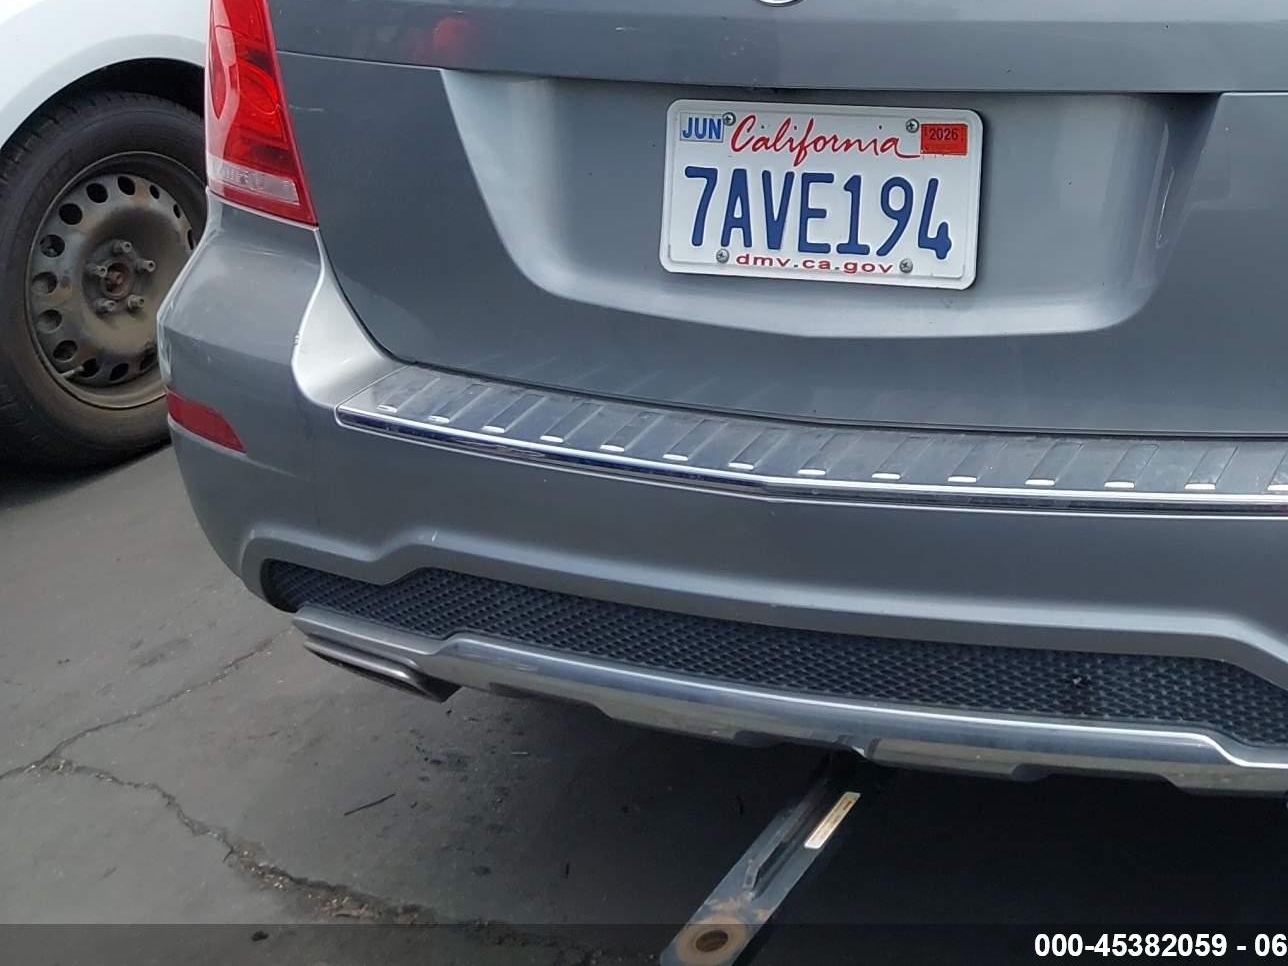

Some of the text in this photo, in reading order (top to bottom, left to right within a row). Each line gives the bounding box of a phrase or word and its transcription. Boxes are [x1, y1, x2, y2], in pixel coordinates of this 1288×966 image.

[682, 116, 722, 140] JUN
[730, 114, 921, 166] California
[929, 127, 958, 141] 2026
[684, 166, 953, 260] 7AVE194
[736, 253, 893, 274] dmv.ca.gov
